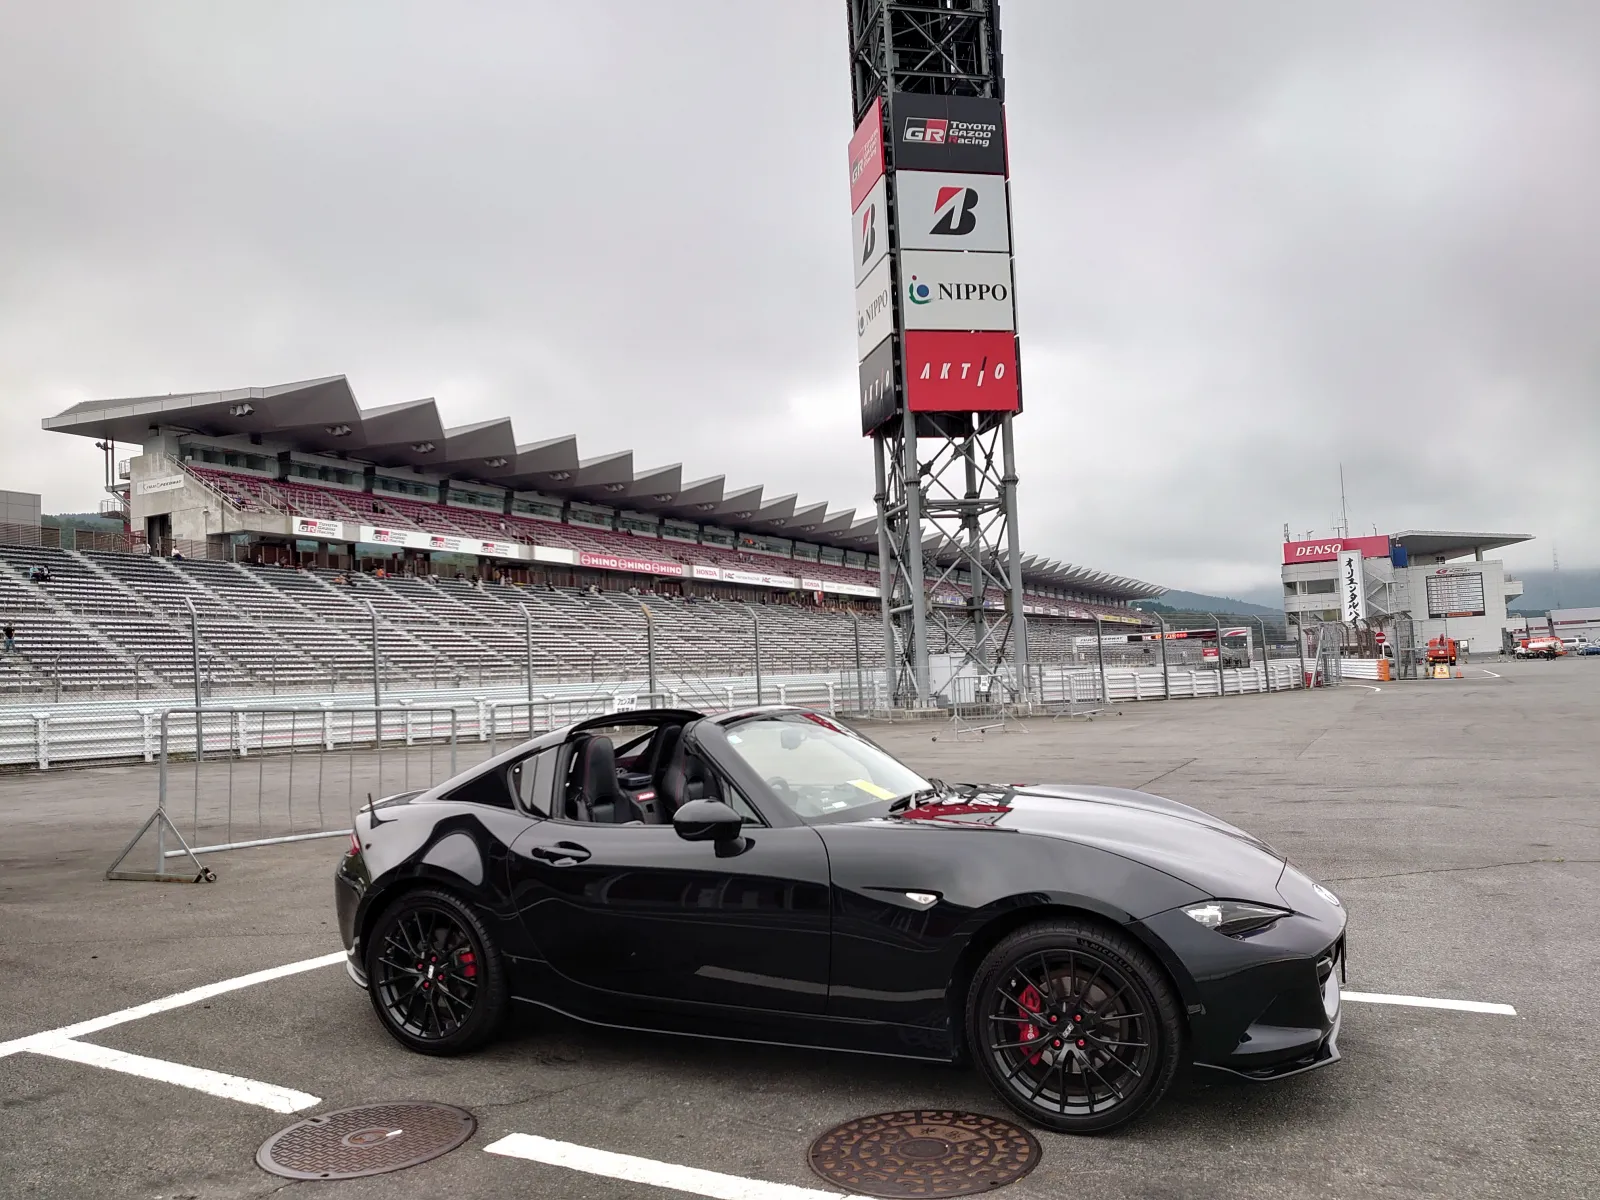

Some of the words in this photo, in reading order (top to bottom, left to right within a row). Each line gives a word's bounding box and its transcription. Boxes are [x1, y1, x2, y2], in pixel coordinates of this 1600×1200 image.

[950, 121, 996, 131] TOYOTA
[905, 127, 945, 142] GR
[949, 129, 992, 138] GAZOO
[948, 136, 990, 147] Racing
[938, 283, 1008, 301] NIPPO
[865, 289, 888, 326] NIPPO
[920, 356, 1005, 387] AKTIO
[300, 524, 316, 533] GR
[1296, 543, 1341, 557] DENSO
[591, 557, 618, 567] HINO
[627, 562, 651, 571] HINO
[660, 565, 682, 574] HINO
[696, 568, 718, 577] HONDA
